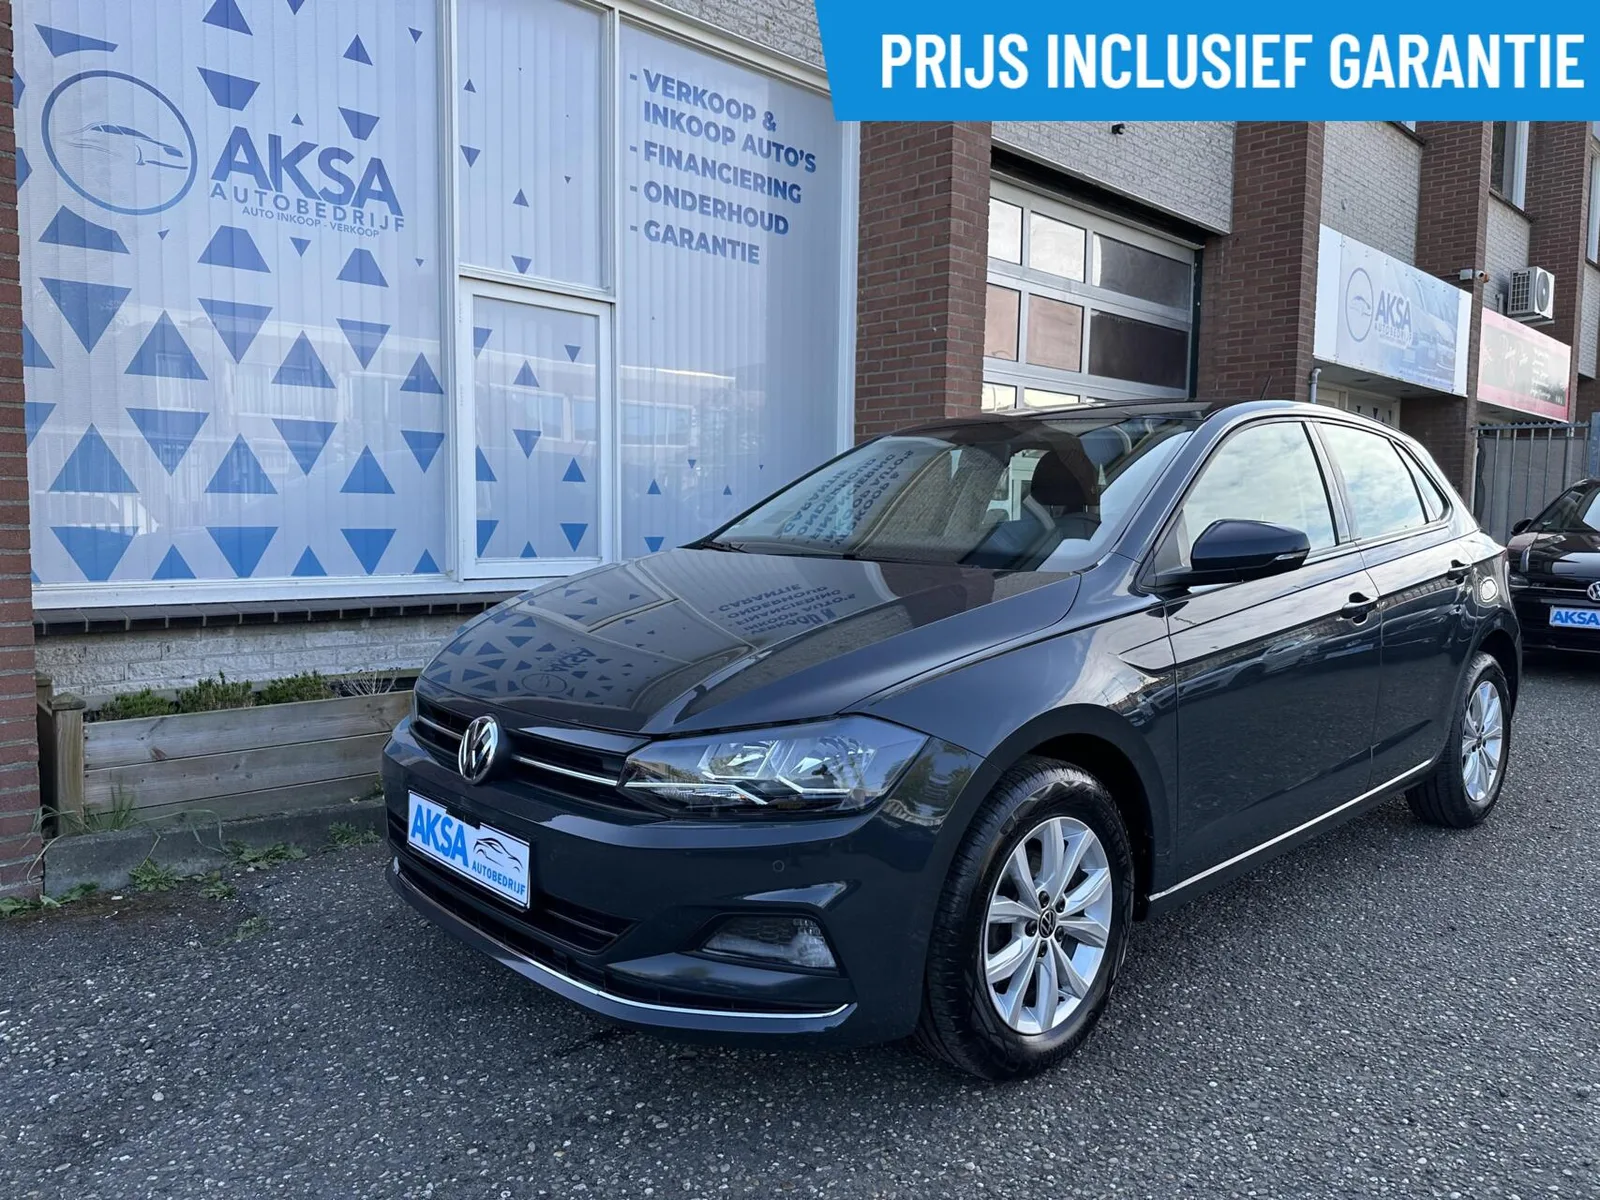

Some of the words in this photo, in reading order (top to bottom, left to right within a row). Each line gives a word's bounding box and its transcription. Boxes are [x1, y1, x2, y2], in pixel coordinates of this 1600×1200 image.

[642, 68, 756, 124] VERKOOP
[762, 111, 777, 132] &
[644, 101, 736, 146] INKOOP
[742, 134, 817, 173] AUTO'S
[210, 125, 404, 217] AKSA
[644, 140, 802, 204] FINANCIERING
[210, 182, 405, 232] AUTOBEDRIJF
[242, 206, 274, 220] AUTO
[277, 212, 321, 228] INKOOP
[329, 221, 380, 238] VERKOOP
[643, 180, 789, 235] ONDERHOUD
[643, 219, 760, 265] GARANTIE
[1375, 290, 1412, 333] AKSA
[1553, 611, 1600, 626] AKSA
[410, 803, 469, 868] AKSA
[471, 860, 526, 896] AUTOBEDRIJF
